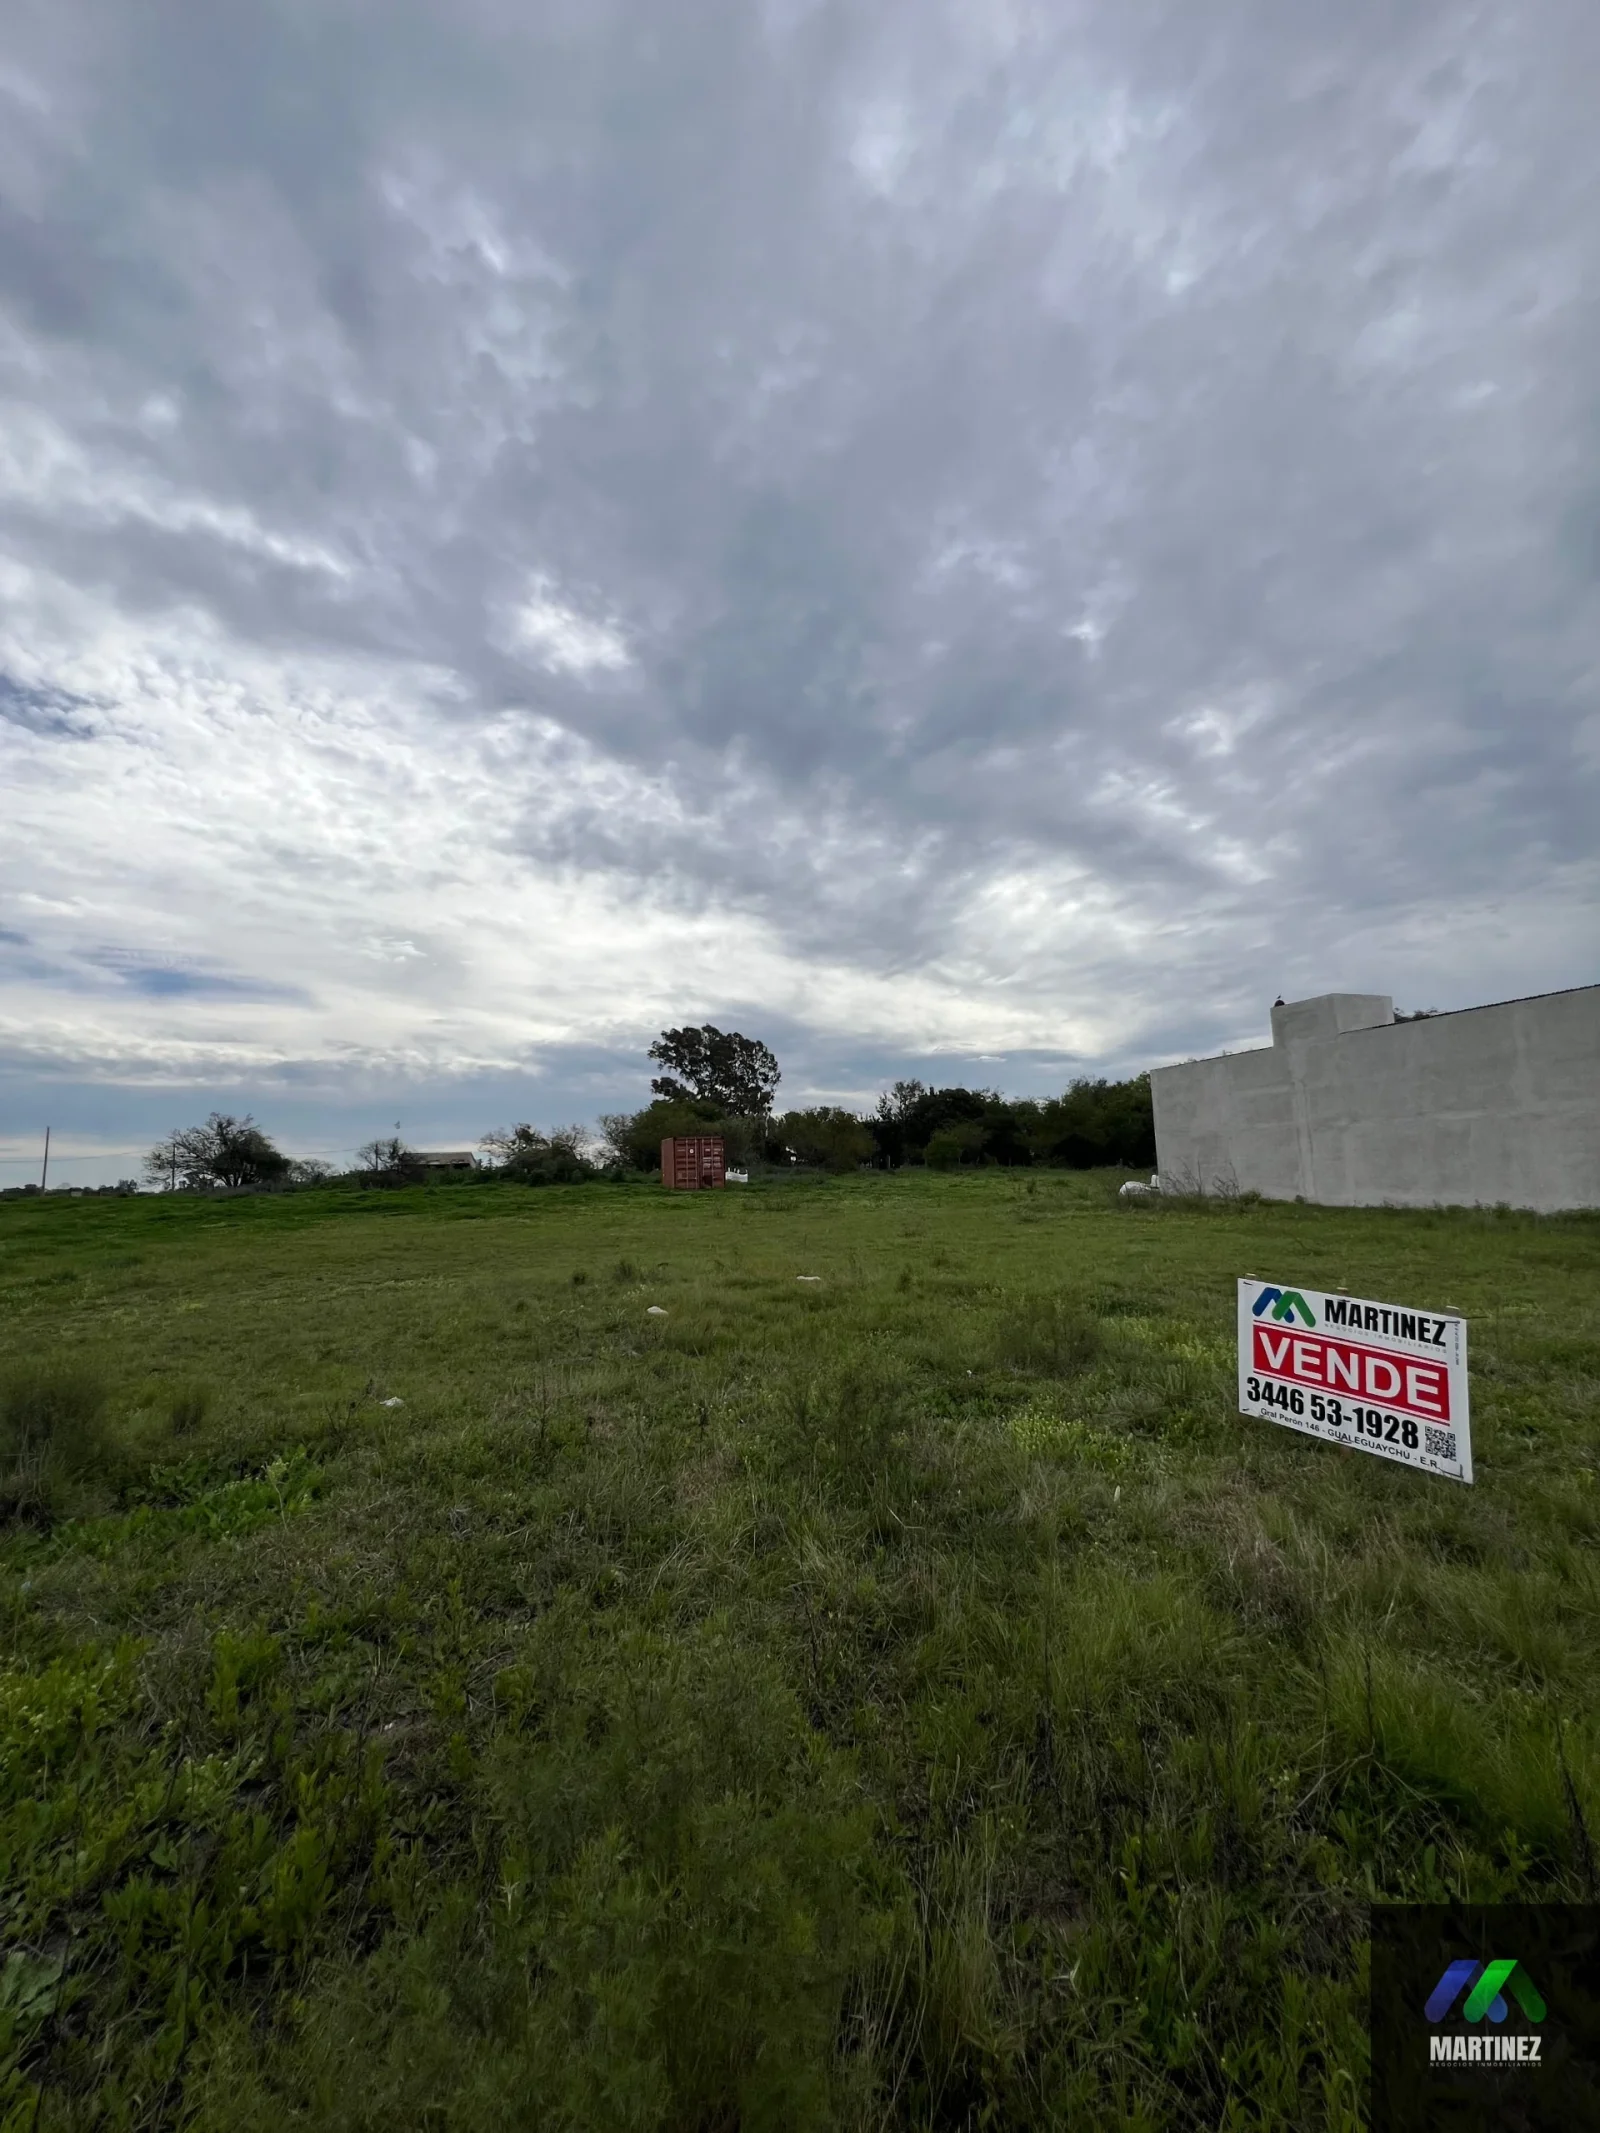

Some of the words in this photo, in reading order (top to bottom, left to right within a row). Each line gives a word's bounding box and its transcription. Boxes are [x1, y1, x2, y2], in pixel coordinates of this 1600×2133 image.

[1324, 1299, 1447, 1347] MARTINEZ
[1324, 1323, 1369, 1338] NEGOCIOS
[1374, 1334, 1448, 1354] INMOBILIARIOS
[1259, 1331, 1442, 1412] VENDE
[1246, 1377, 1304, 1415] 3446
[1310, 1393, 1419, 1449] 53-1928
[1260, 1407, 1277, 1419] Gral
[1279, 1413, 1303, 1427] Perón
[1305, 1421, 1320, 1432] 146
